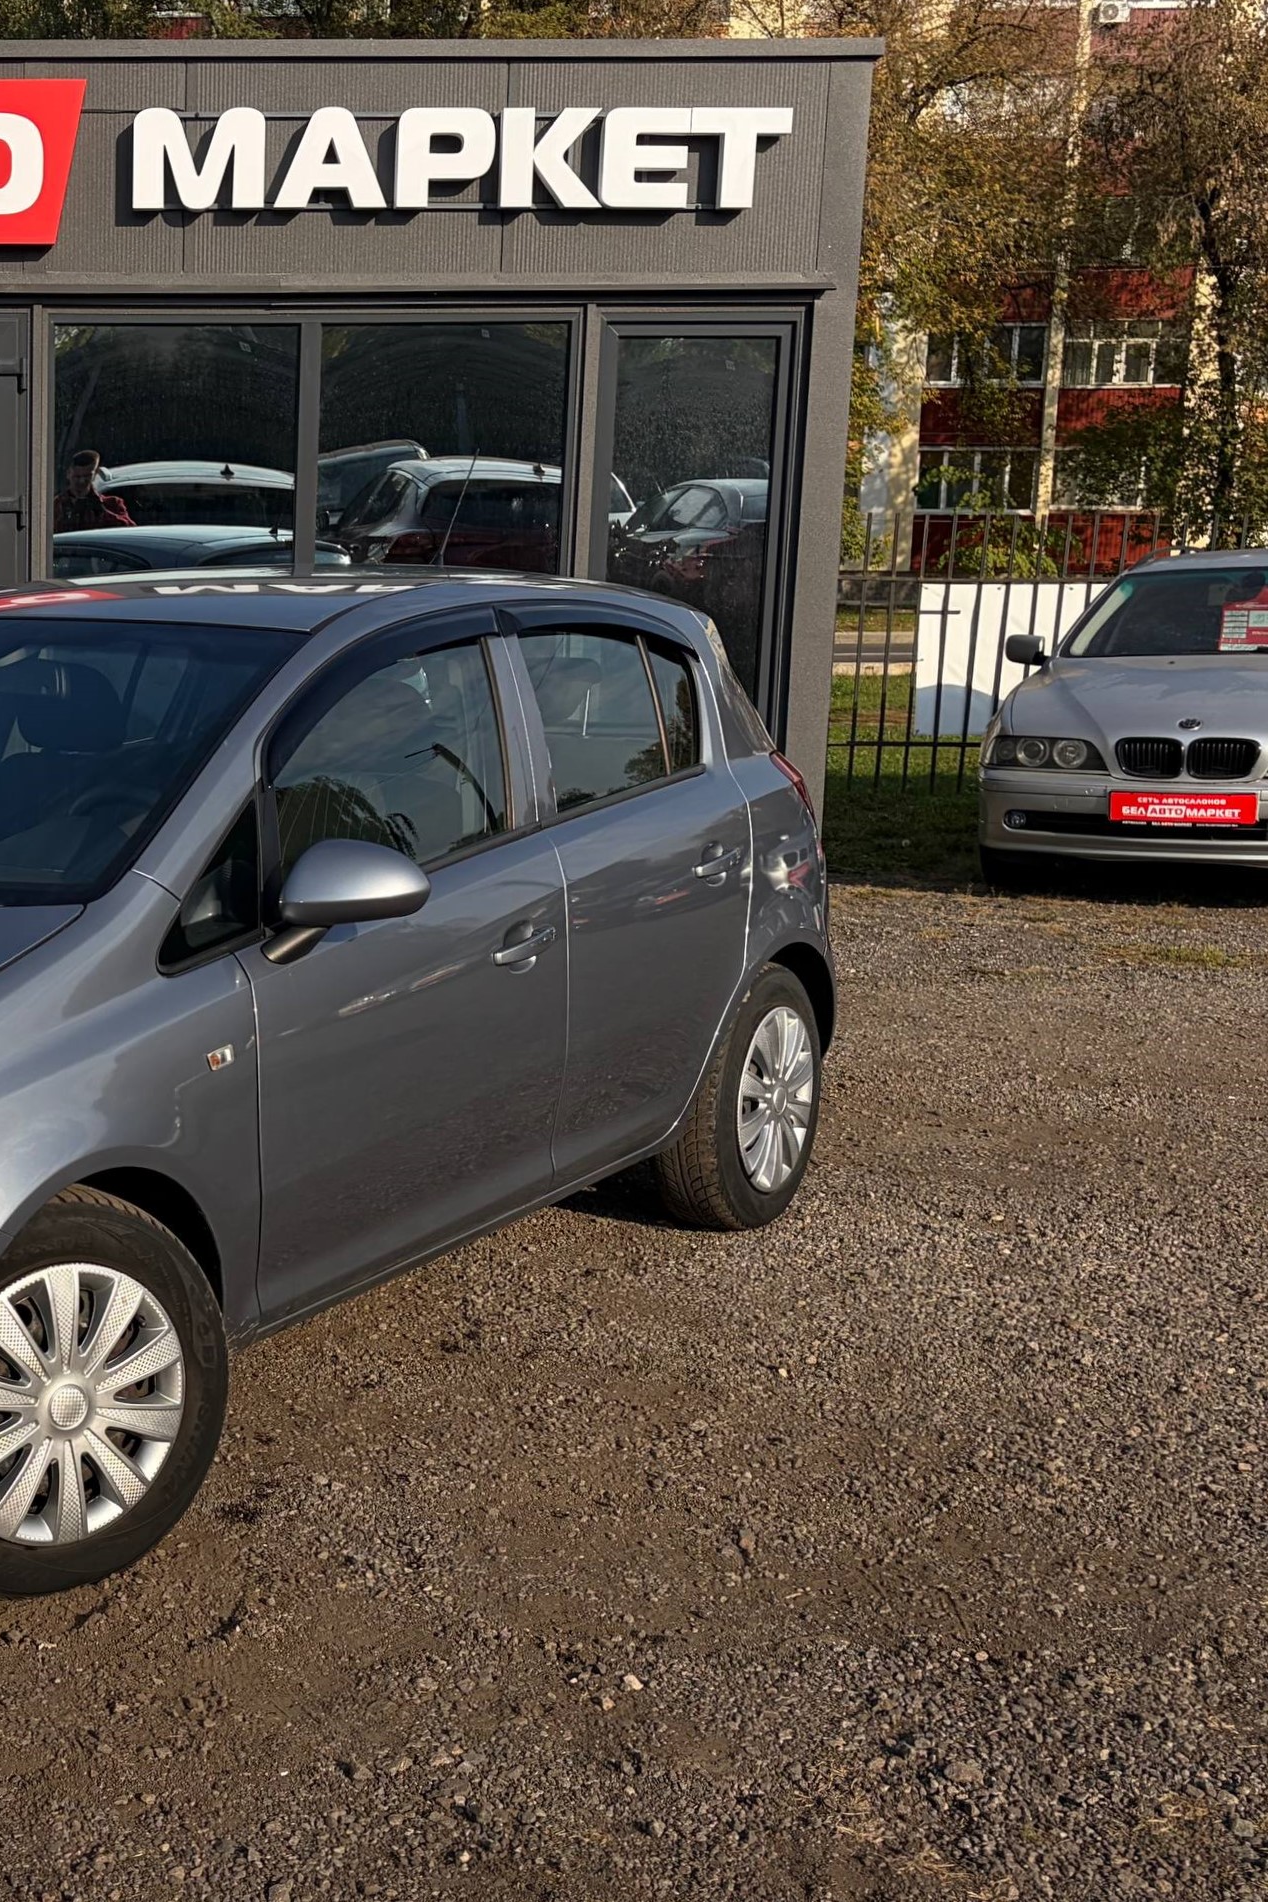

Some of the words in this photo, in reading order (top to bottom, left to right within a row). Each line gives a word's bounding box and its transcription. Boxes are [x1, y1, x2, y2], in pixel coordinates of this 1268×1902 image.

[131, 107, 794, 210] МАРКЕТ
[1122, 806, 1146, 815] БЕЛ
[1148, 807, 1183, 816] АВТО
[1186, 808, 1241, 818] МАРКЕТ
